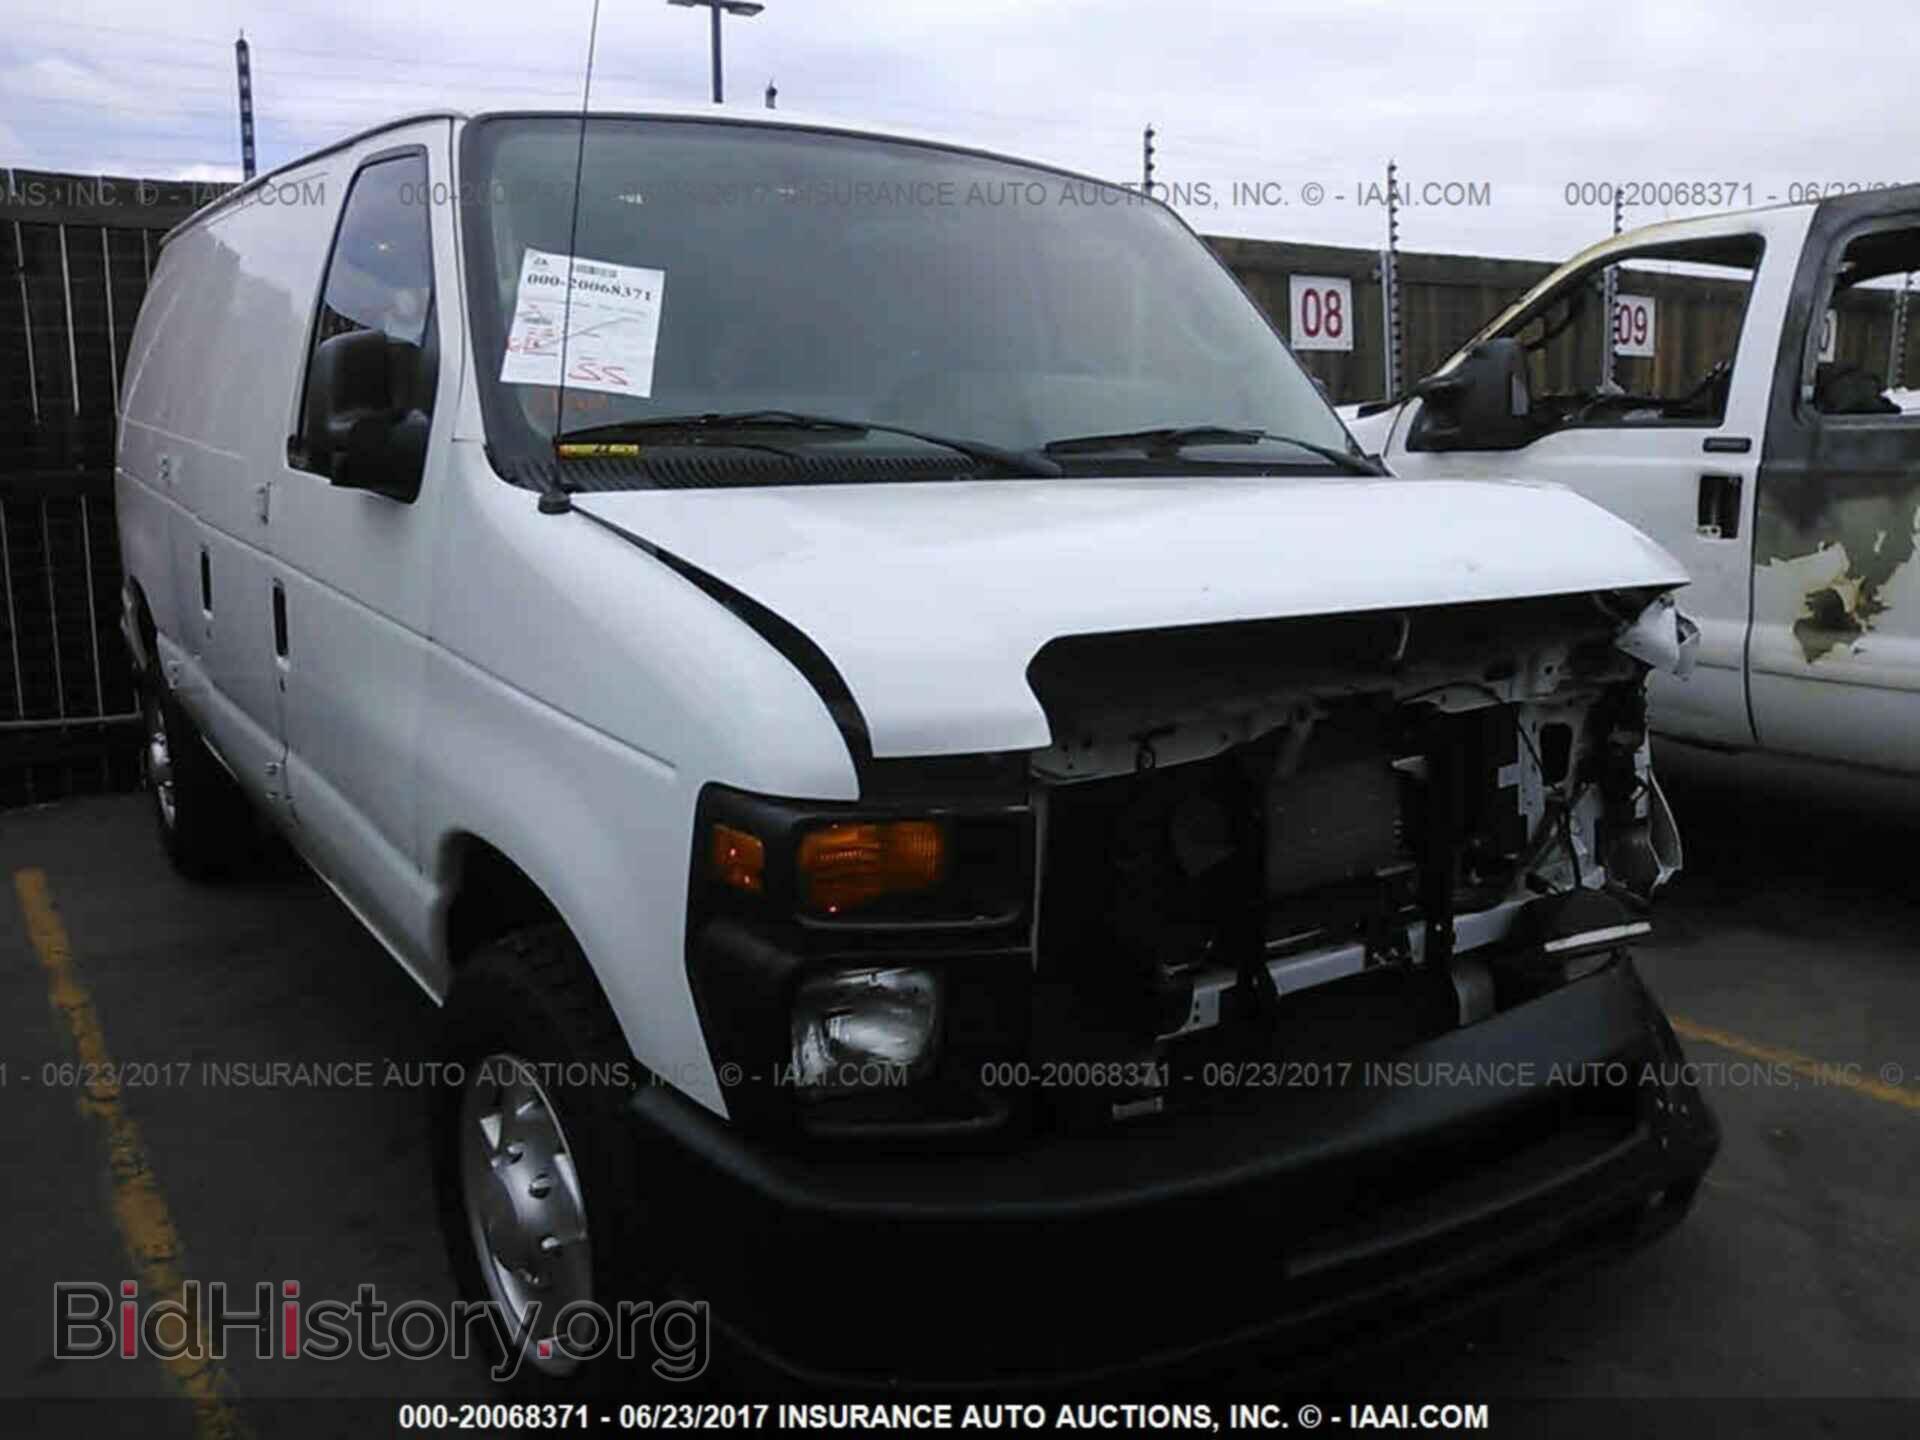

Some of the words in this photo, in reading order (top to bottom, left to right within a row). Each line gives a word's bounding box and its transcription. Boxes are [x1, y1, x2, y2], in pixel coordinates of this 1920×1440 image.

[527, 273, 652, 302] 000-20068371
[1301, 287, 1343, 338] 08
[1617, 304, 1648, 346] 09
